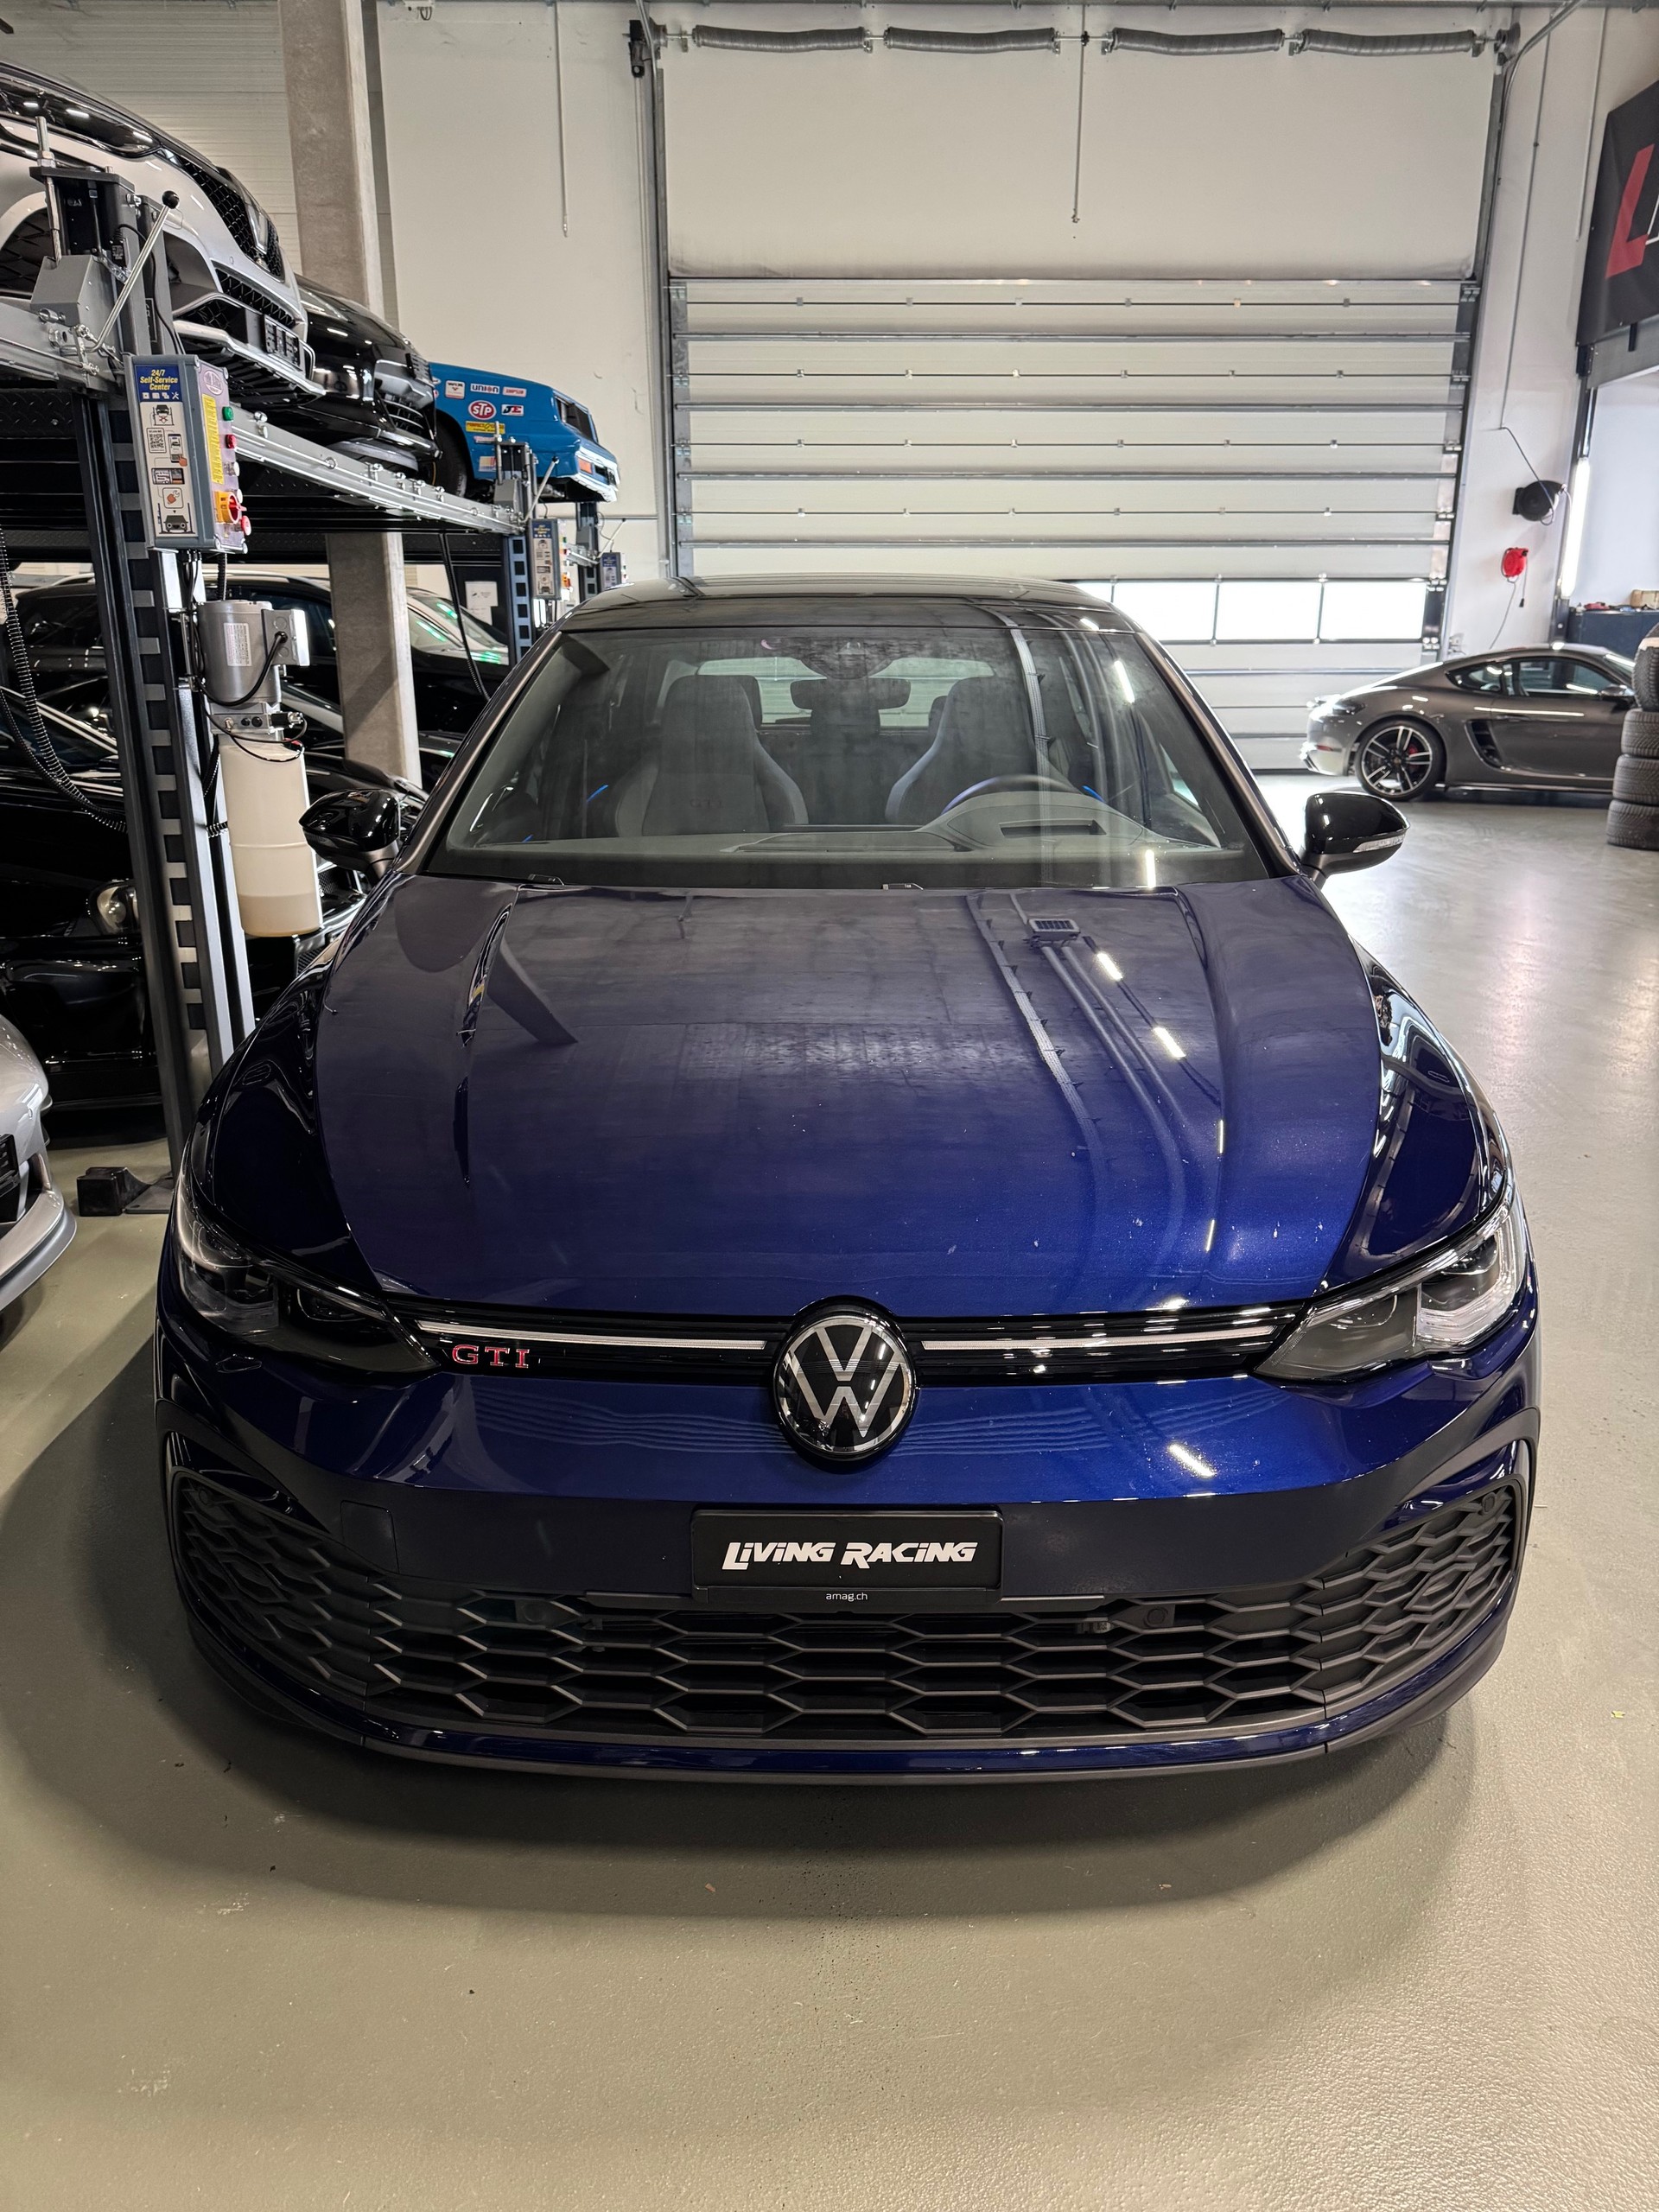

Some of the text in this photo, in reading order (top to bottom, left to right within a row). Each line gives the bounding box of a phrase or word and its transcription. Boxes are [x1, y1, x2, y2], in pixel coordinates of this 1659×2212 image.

[1605, 143, 1659, 279] L
[473, 403, 493, 416] STP
[452, 1344, 530, 1369] GTI
[826, 1592, 868, 1602] amag.ch
